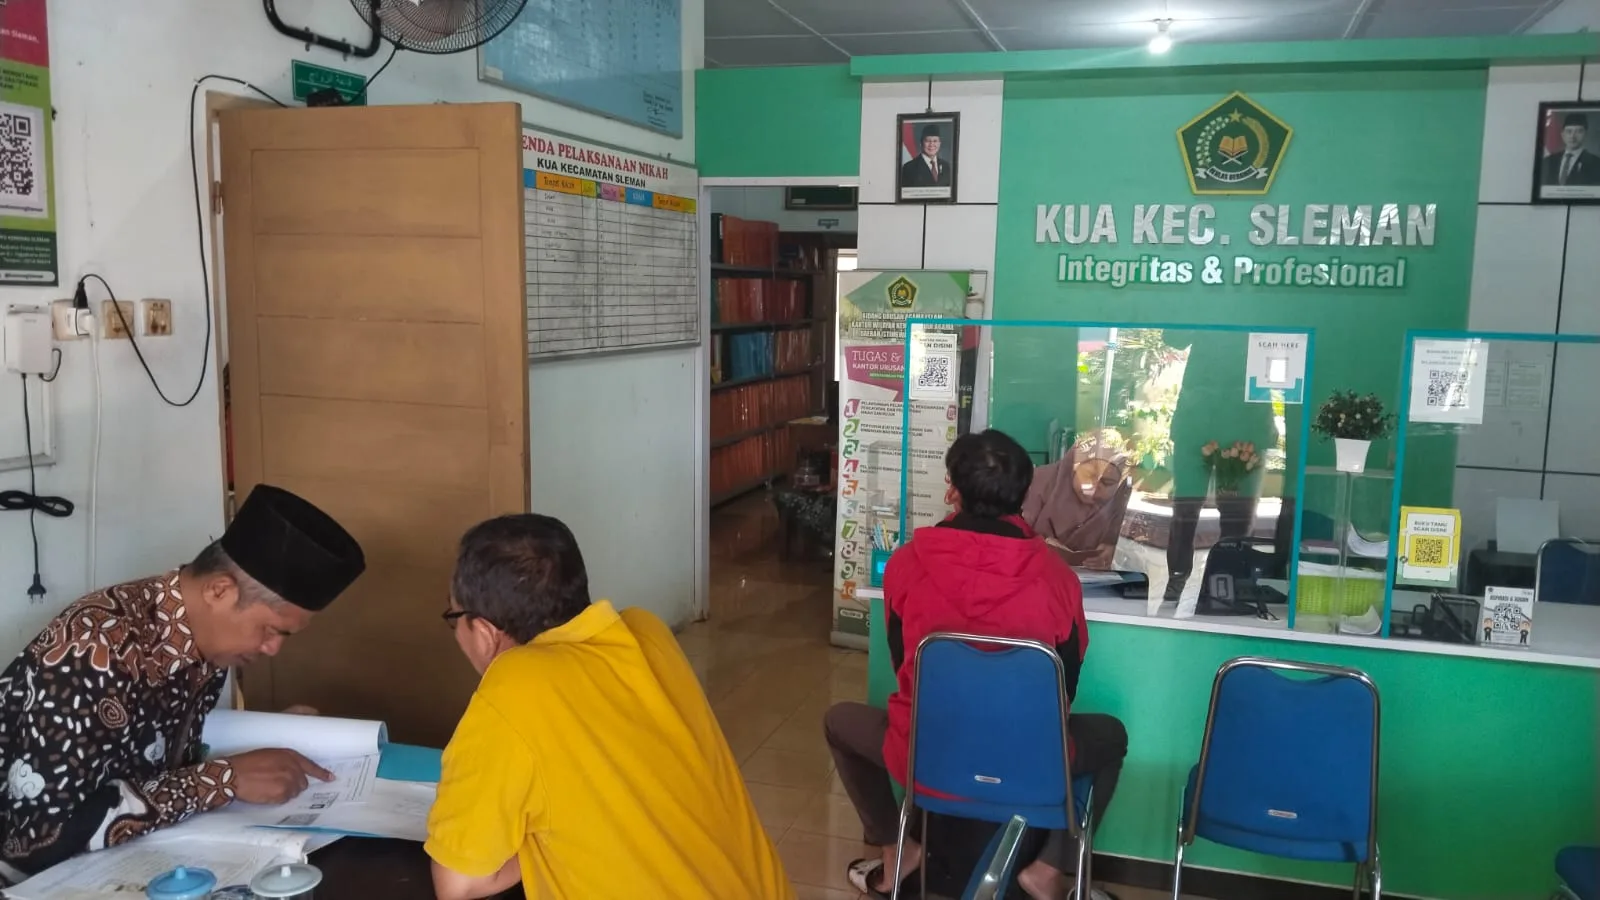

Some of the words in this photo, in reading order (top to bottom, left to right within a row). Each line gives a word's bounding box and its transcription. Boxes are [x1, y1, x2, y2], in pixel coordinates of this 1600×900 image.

[558, 143, 636, 173] PELAKSANAAN
[639, 162, 668, 180] NIKAH
[537, 157, 558, 171] KUA
[561, 163, 613, 182] KECAMATAN
[615, 174, 646, 188] SLEMAN
[1034, 203, 1118, 245] KUA
[1133, 203, 1230, 246] KEC.
[1248, 202, 1437, 247] SLEMAN
[1057, 254, 1194, 288] Integritas
[1201, 256, 1223, 285] &
[1233, 256, 1406, 288] Profesional
[851, 350, 888, 362] TUGAS
[890, 351, 902, 363] &
[852, 362, 879, 371] KANTOR
[844, 420, 857, 437] 2
[844, 441, 857, 458] 3
[844, 521, 857, 539] 7
[842, 541, 854, 559] 8
[843, 562, 855, 579] 9
